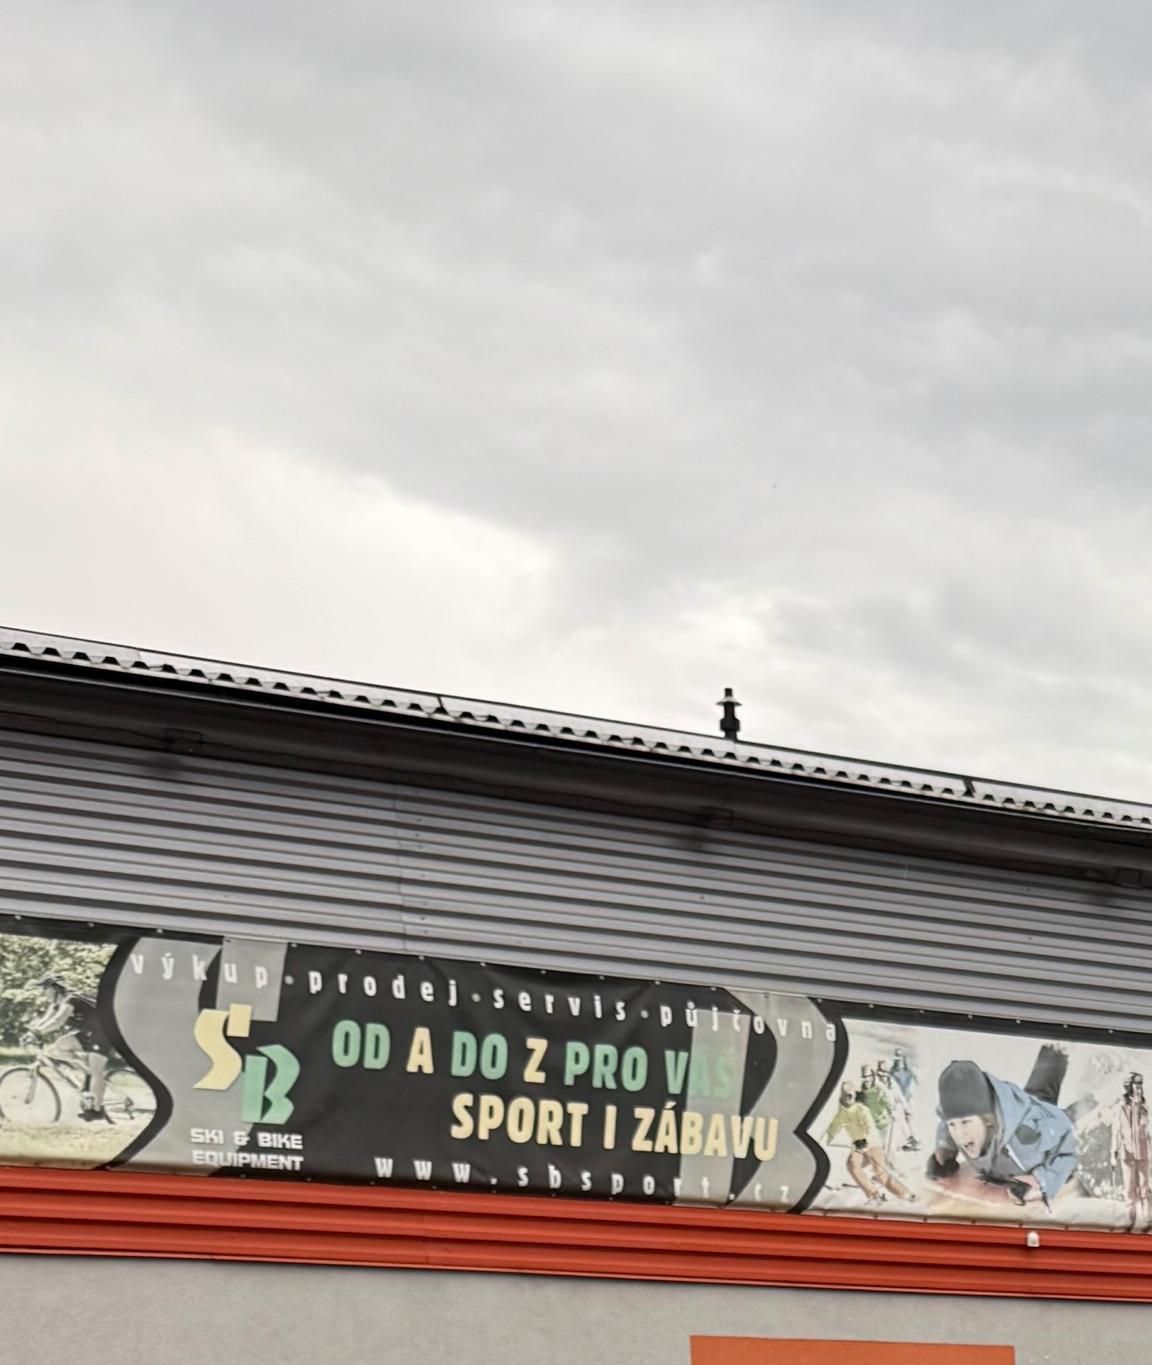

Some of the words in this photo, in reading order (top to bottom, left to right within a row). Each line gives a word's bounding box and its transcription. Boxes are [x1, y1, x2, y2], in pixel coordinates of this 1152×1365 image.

[129, 952, 268, 989] výkup
[308, 971, 457, 1006] prodej
[493, 988, 625, 1021] servis
[660, 1002, 836, 1042] půjčovna
[331, 1019, 391, 1070] OD
[406, 1026, 434, 1074] A
[451, 1031, 508, 1080] DO
[523, 1037, 548, 1084] Z
[563, 1041, 648, 1092] PRO
[190, 1127, 224, 1144] SKI
[233, 1131, 250, 1146] &
[258, 1132, 304, 1150] BIKE
[191, 1150, 304, 1171] EQUIPMENT
[450, 1092, 589, 1148] SPORT
[604, 1105, 617, 1149] I
[631, 1101, 779, 1162] ZÁBAVU
